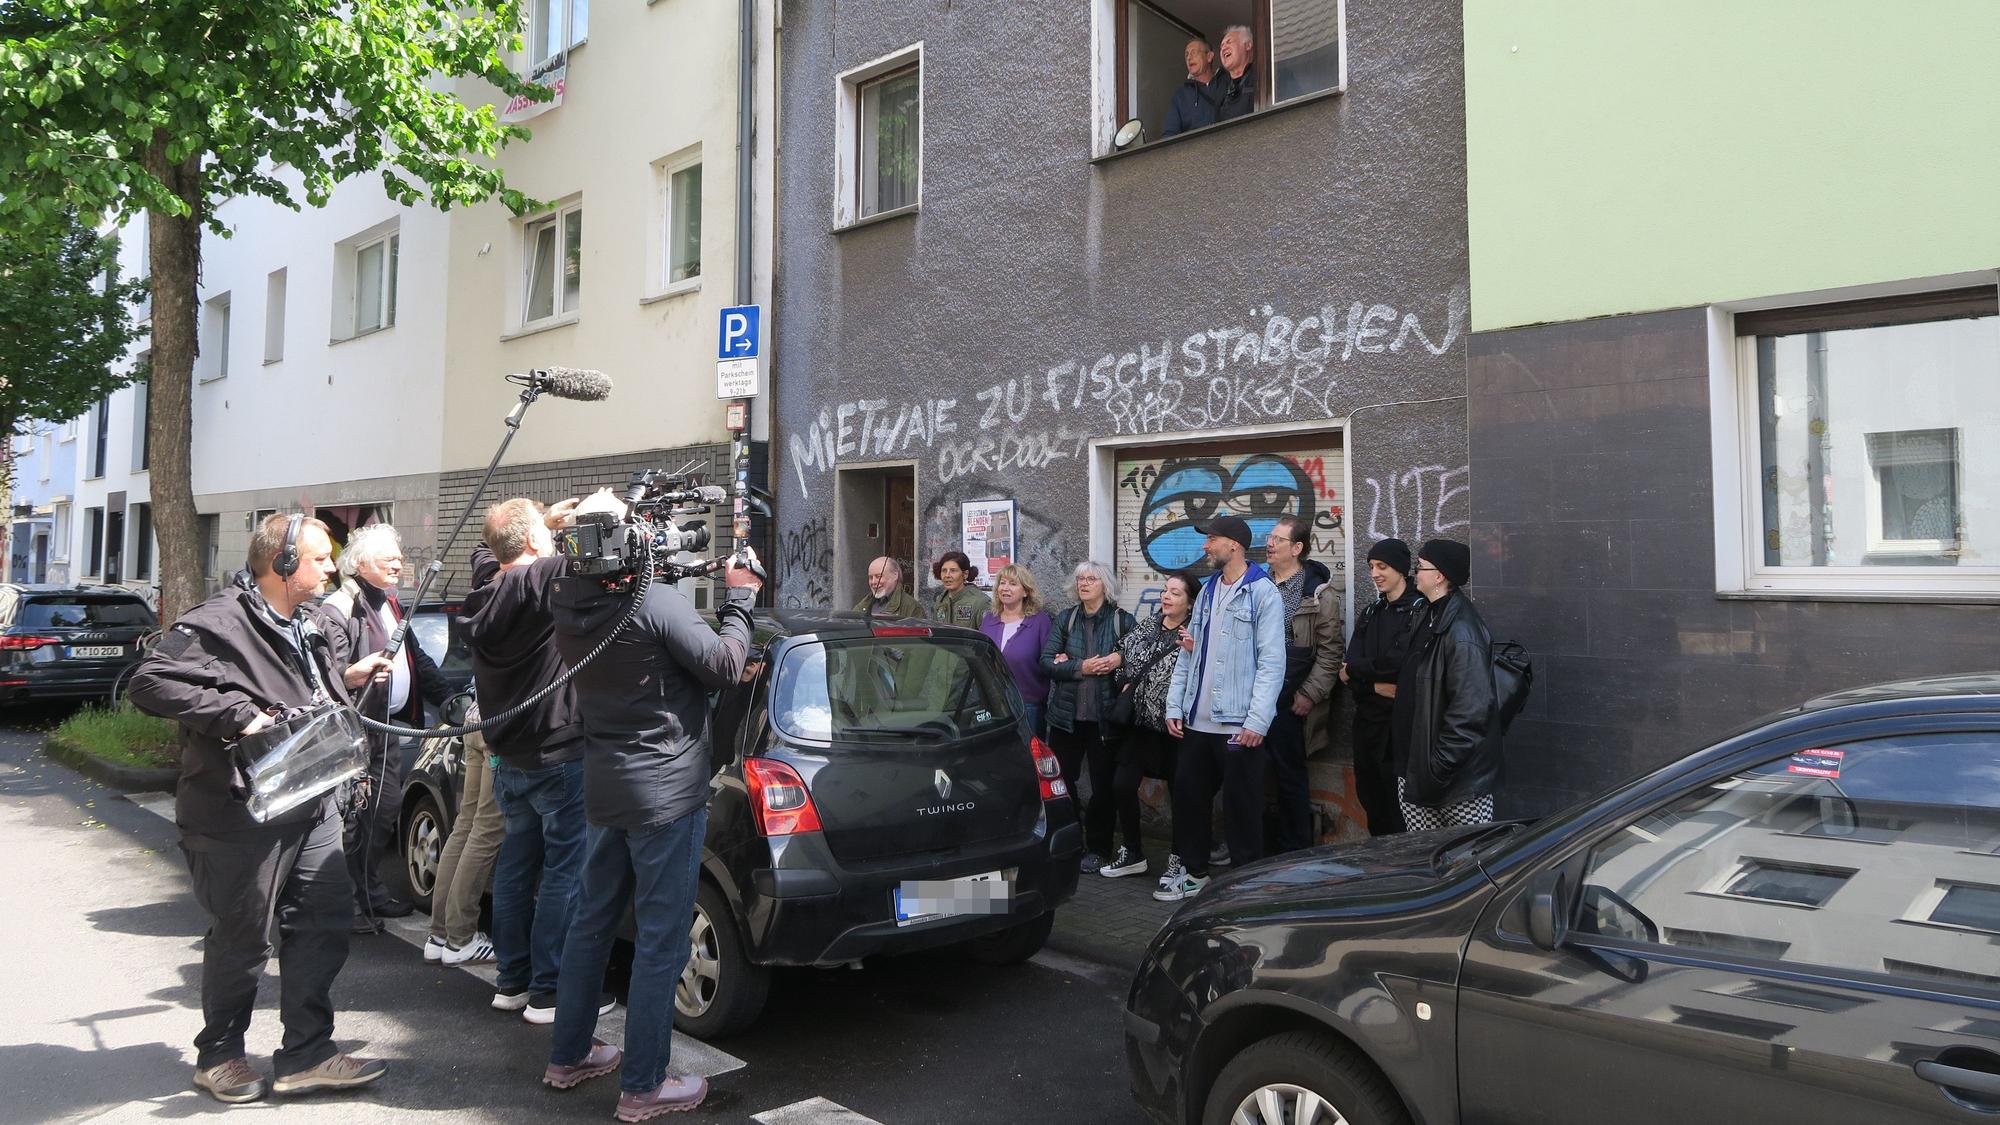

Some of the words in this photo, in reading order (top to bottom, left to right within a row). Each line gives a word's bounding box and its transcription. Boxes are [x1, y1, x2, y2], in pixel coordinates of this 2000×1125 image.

[725, 313, 748, 352] P
[732, 361, 742, 369] mit
[720, 369, 755, 379] Parkschein
[723, 379, 752, 388] werktags
[976, 374, 1032, 425] ZU
[75, 647, 82, 656] K
[101, 647, 119, 656] 200
[916, 801, 975, 816] TWINGO
